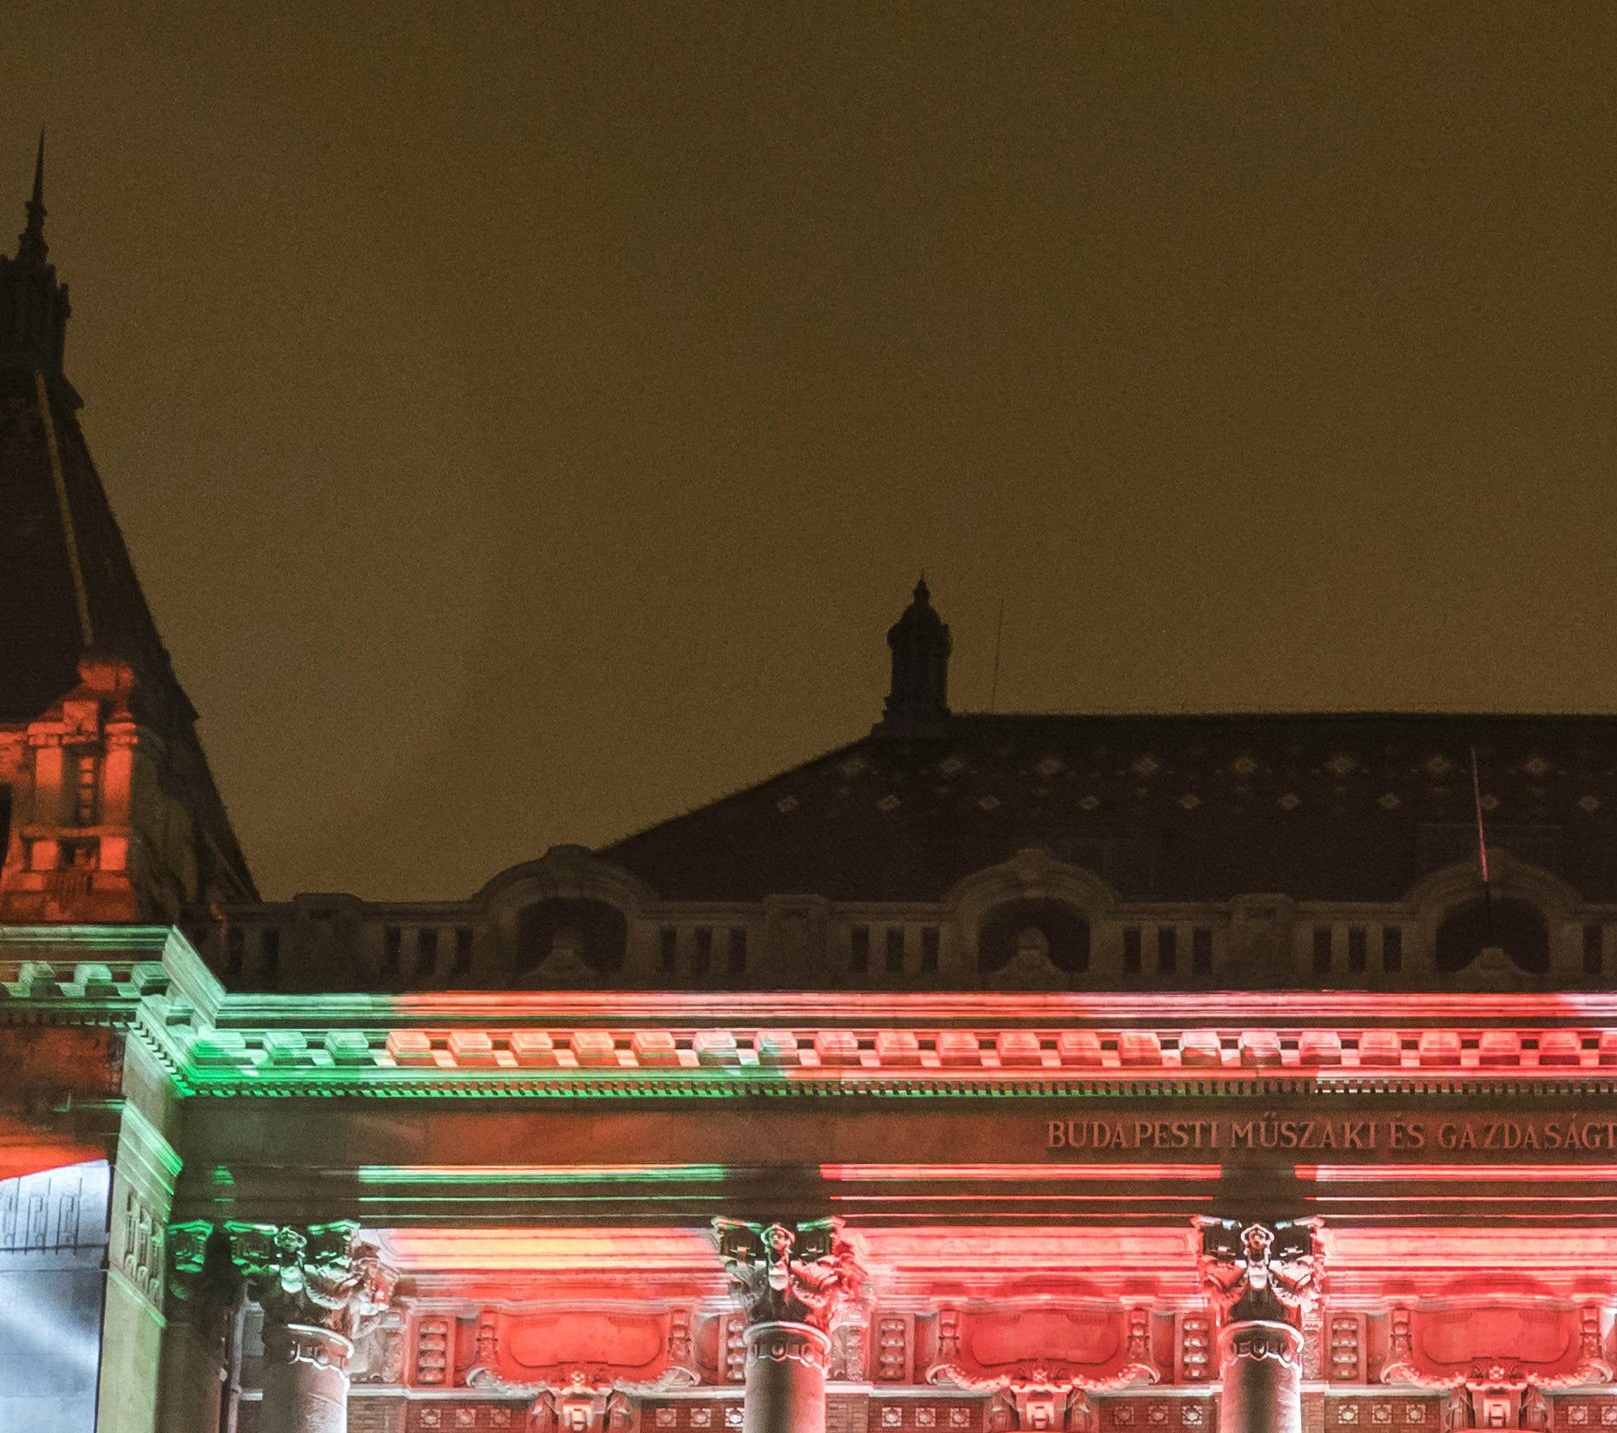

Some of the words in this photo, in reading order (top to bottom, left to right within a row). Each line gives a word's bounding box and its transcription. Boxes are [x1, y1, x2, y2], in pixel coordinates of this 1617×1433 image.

[1046, 1120, 1218, 1149] BUDAPESTI
[1231, 1111, 1378, 1149] MŰSZAKI
[1388, 1112, 1426, 1149] ÉS
